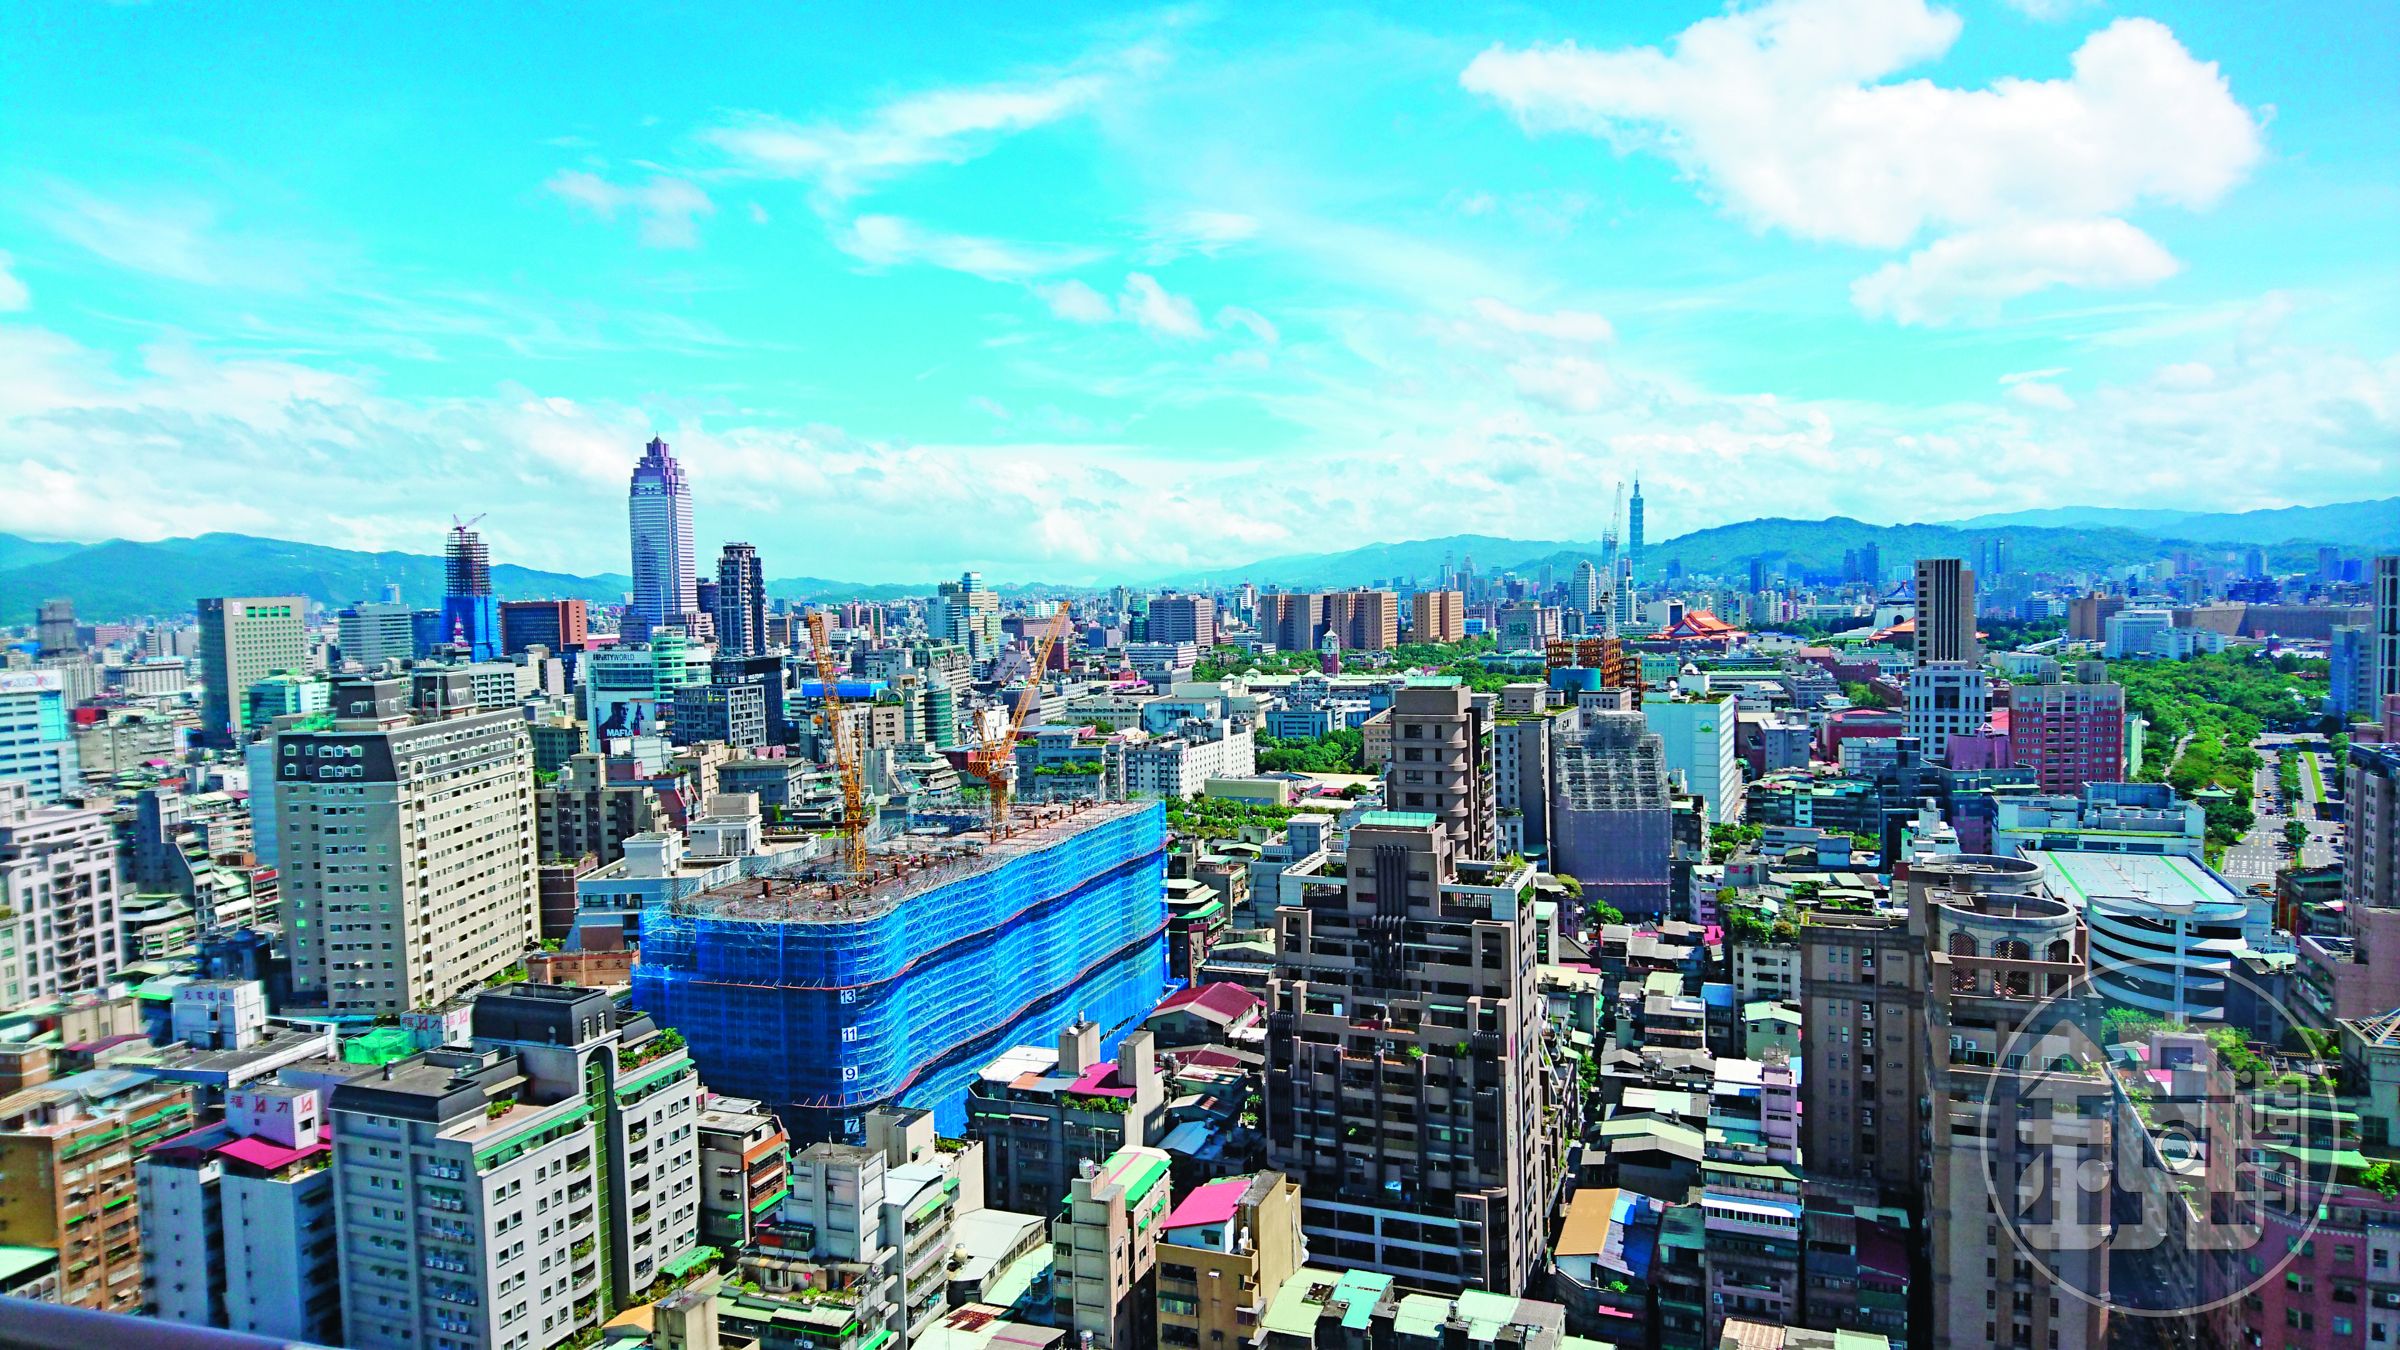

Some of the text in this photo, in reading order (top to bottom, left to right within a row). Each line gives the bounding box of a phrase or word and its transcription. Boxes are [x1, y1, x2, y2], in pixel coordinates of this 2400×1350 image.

[606, 728, 634, 737] MAFIA
[841, 990, 855, 1003] 13
[843, 1028, 856, 1041] 11
[845, 1067, 856, 1080] 9
[847, 1119, 857, 1132] 7
